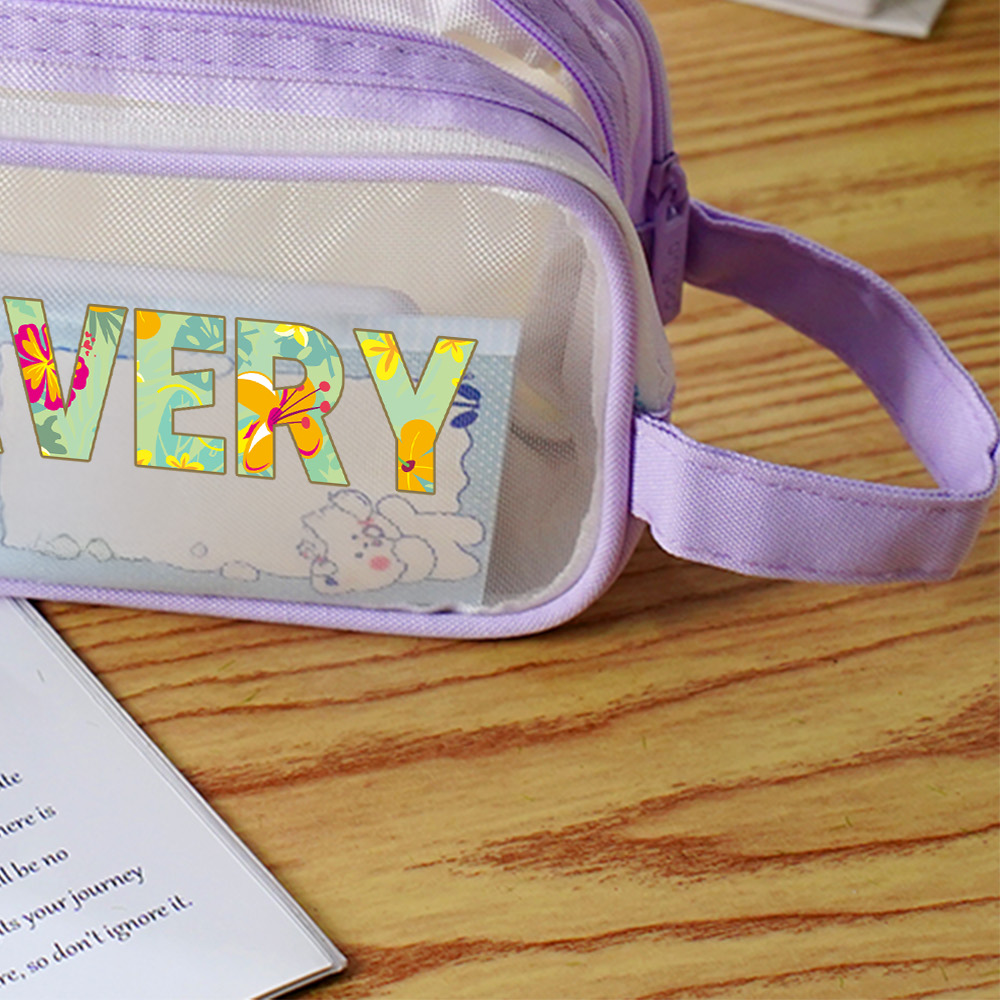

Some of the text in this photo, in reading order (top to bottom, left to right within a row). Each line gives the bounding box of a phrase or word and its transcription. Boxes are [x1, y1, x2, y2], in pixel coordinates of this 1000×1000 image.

[34, 805, 57, 820] is
[8, 860, 40, 879] be
[40, 848, 69, 867] no
[20, 896, 67, 931] your
[66, 865, 144, 912] journey
[25, 956, 50, 974] so
[51, 929, 104, 963] don't
[102, 904, 169, 942] ignore
[166, 894, 193, 912] it.
